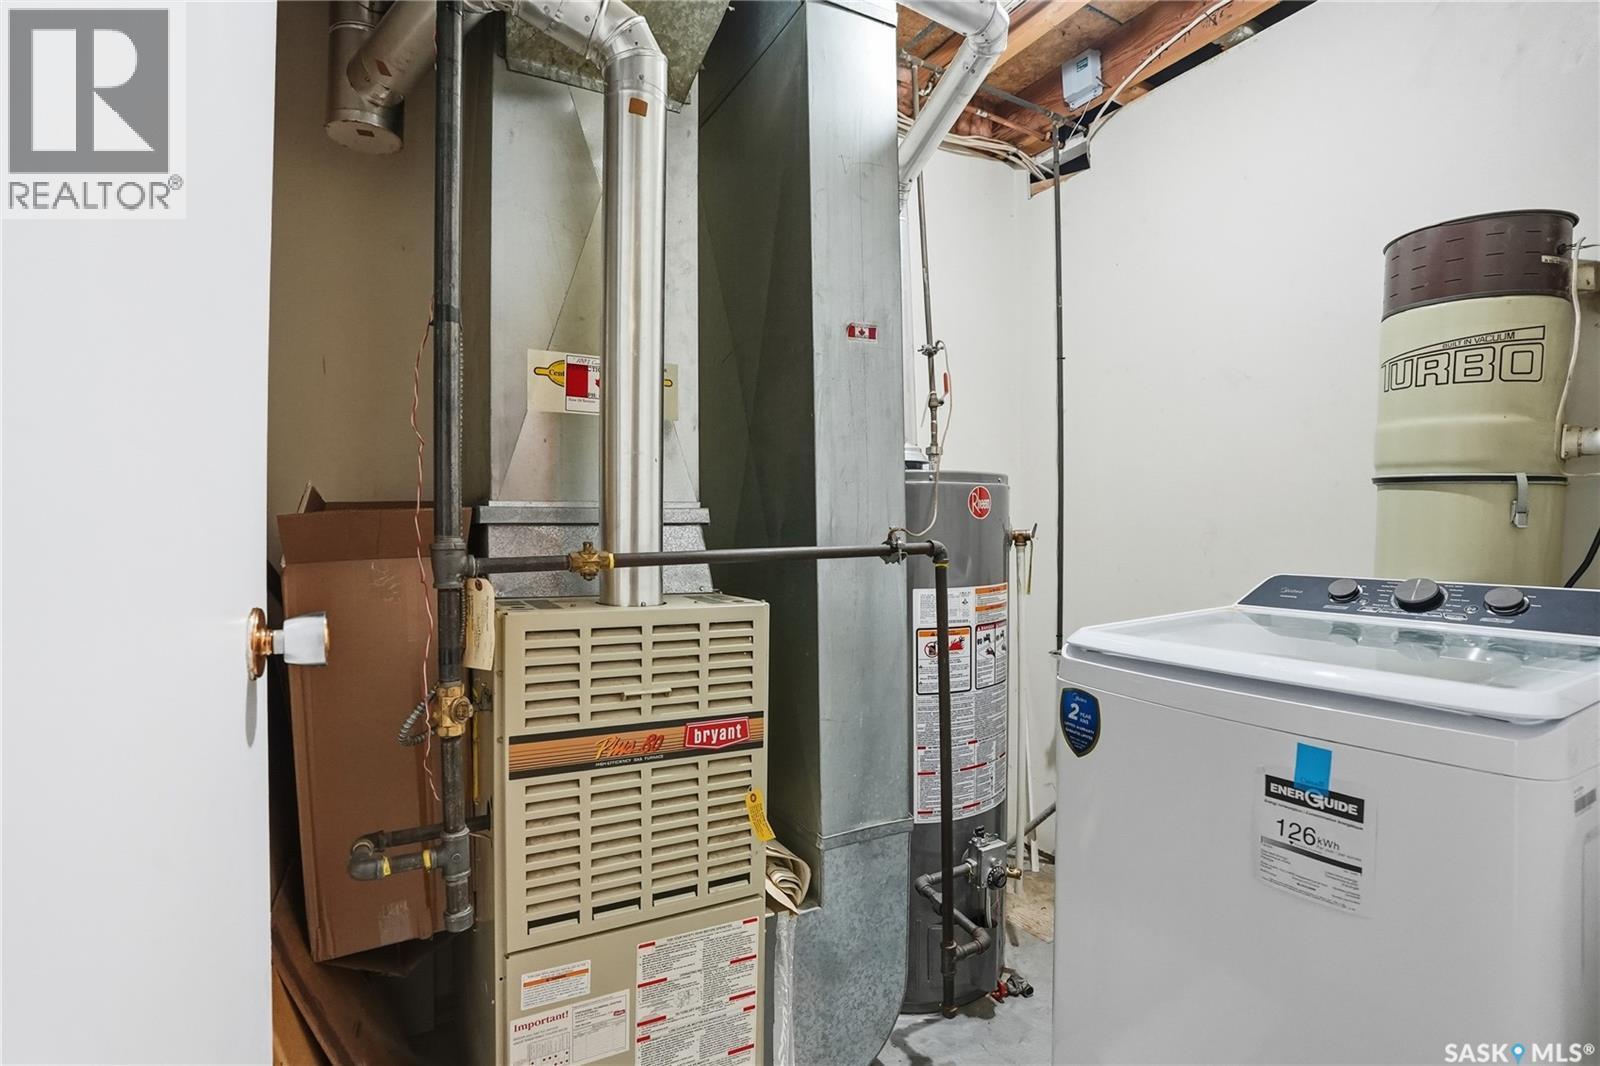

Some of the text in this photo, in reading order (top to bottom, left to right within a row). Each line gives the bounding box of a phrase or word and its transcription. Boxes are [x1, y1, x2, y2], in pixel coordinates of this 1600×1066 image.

[1442, 331, 1516, 350] BUILT IN VACUUM
[1381, 339, 1545, 392] TURBO
[1068, 703, 1080, 720] 2
[641, 734, 665, 753] 80
[694, 723, 742, 746] bryant
[1276, 819, 1340, 850] 126 kWh
[513, 1010, 569, 1033] Important!
